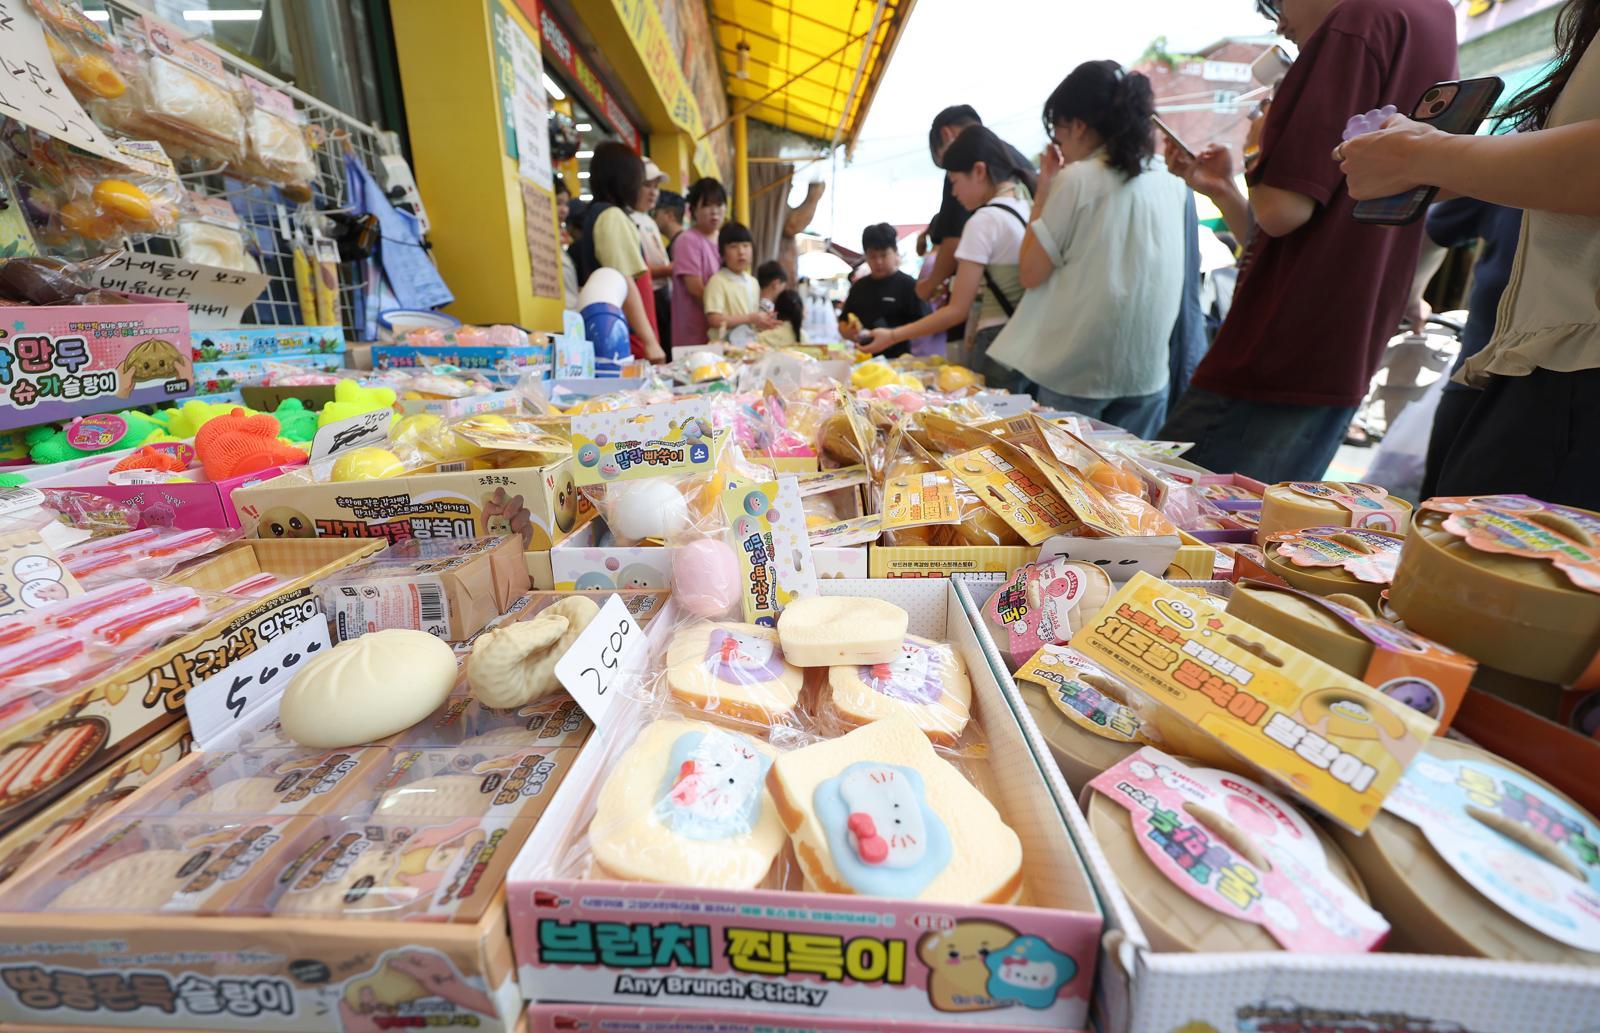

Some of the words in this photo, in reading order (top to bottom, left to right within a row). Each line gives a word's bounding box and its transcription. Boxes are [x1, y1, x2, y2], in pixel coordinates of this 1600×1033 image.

[211, 271, 247, 285] 보고
[15, 336, 90, 375] 만두
[10, 370, 119, 406] 슈가슬랑이
[365, 411, 389, 426] 2500
[355, 507, 378, 519] 만지는
[378, 506, 396, 518] 순간
[396, 502, 434, 516] 스트레스가
[582, 619, 629, 697] 2500
[1096, 616, 1179, 671] 치즈빵
[226, 641, 322, 718] 5000
[537, 917, 713, 969] 브런치
[724, 926, 906, 985] 찐득이
[614, 974, 662, 997] Any
[663, 975, 748, 1000] Brunch
[748, 980, 828, 1007] Sticky
